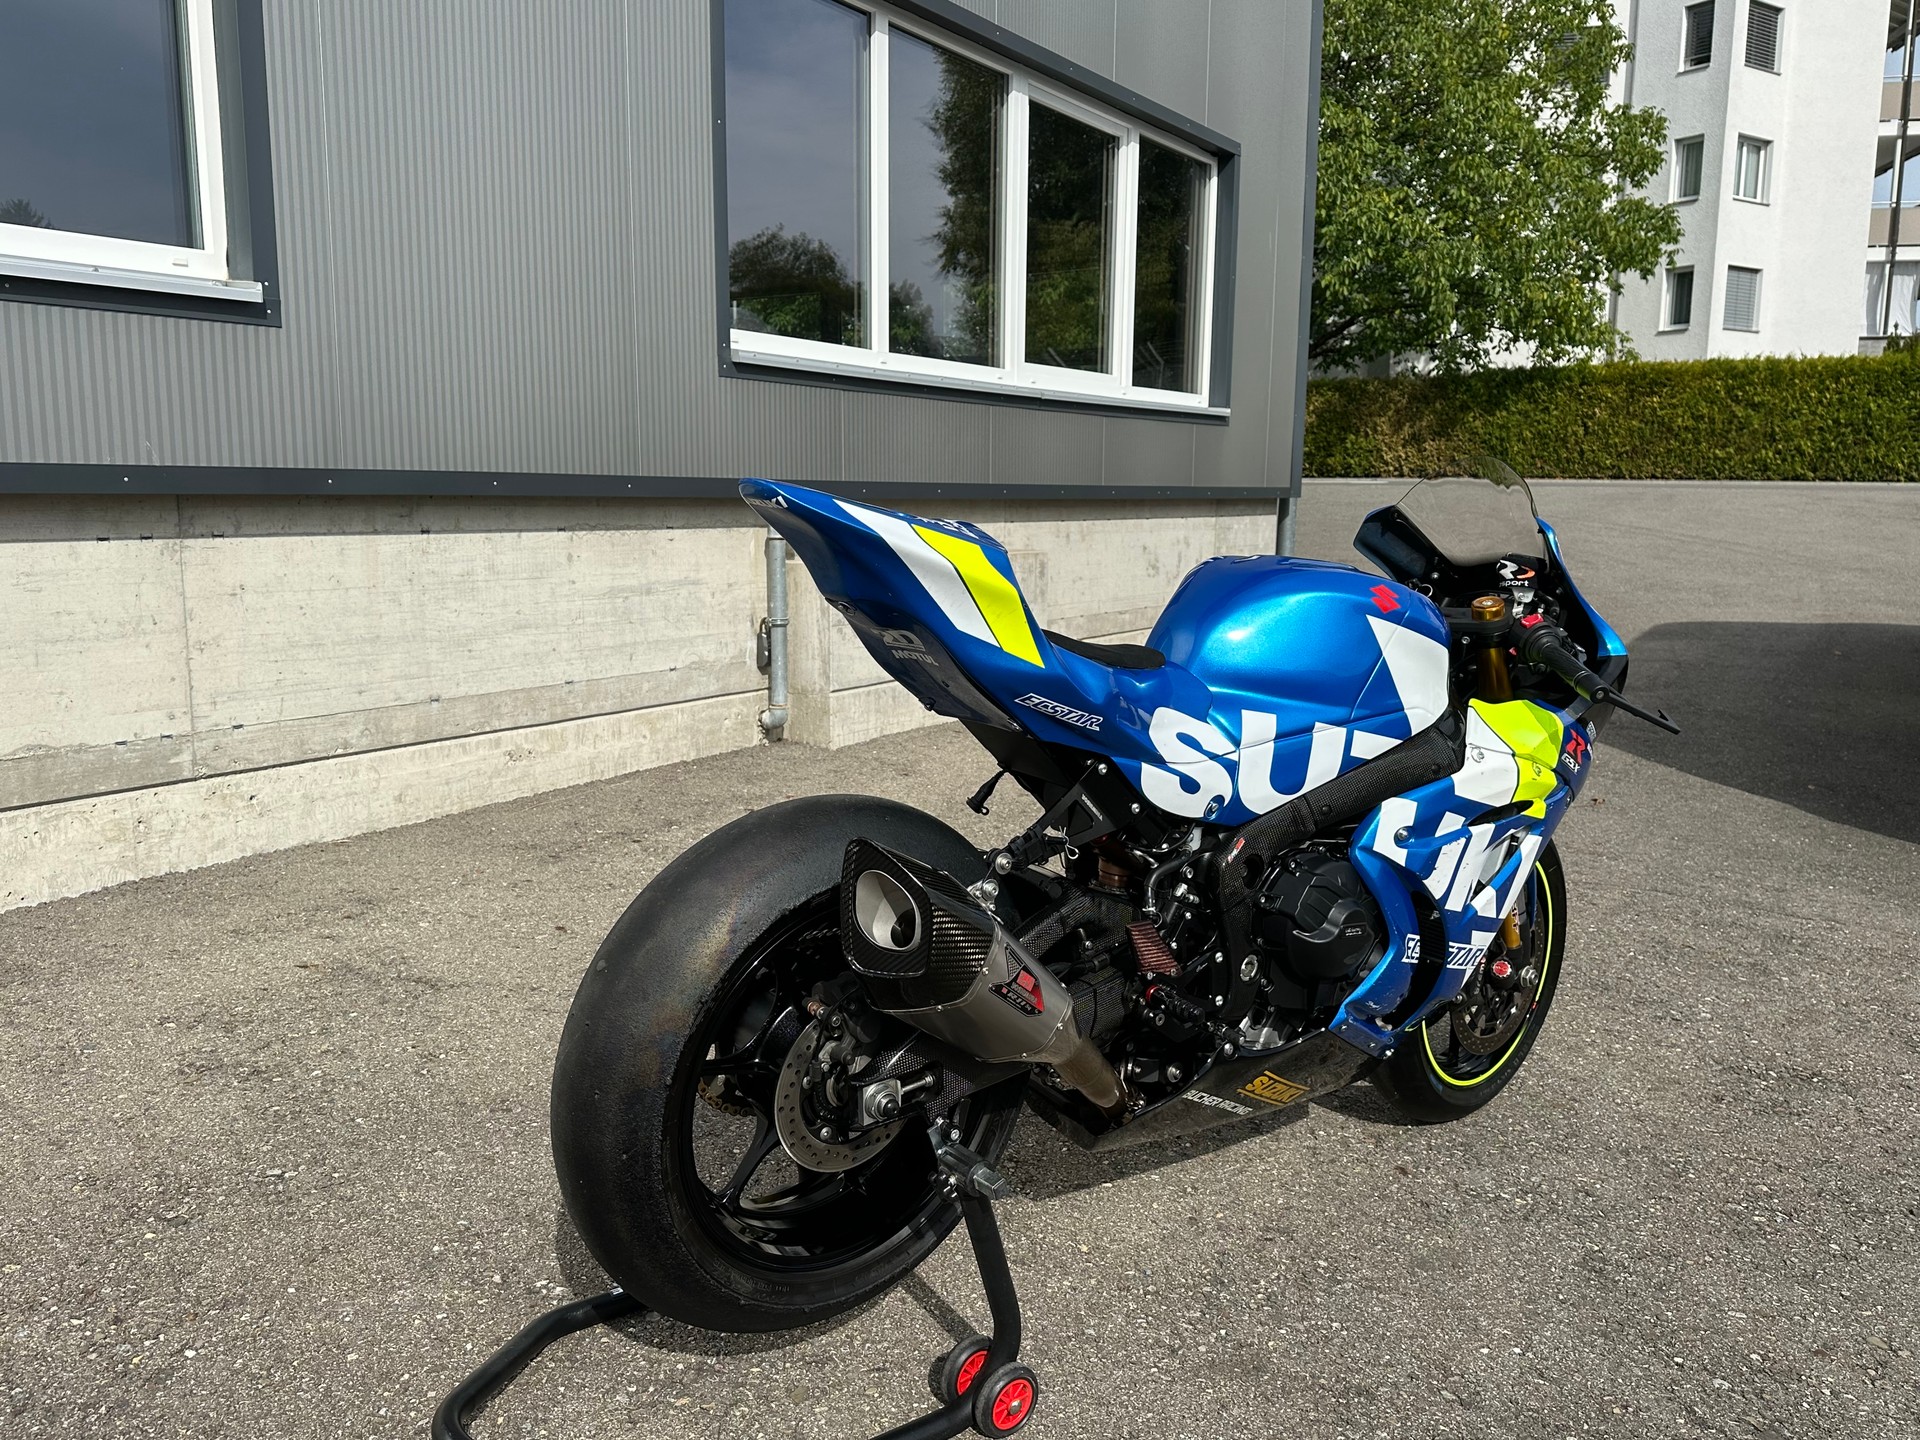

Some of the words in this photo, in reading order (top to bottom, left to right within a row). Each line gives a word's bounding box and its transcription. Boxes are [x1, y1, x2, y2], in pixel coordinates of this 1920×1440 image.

[891, 649, 939, 667] MOTUL
[1013, 692, 1104, 732] ECSTAR
[1182, 1089, 1223, 1107] BUCHER
[1216, 1099, 1254, 1115] RACING
[1245, 1075, 1305, 1103] SUZUKI
